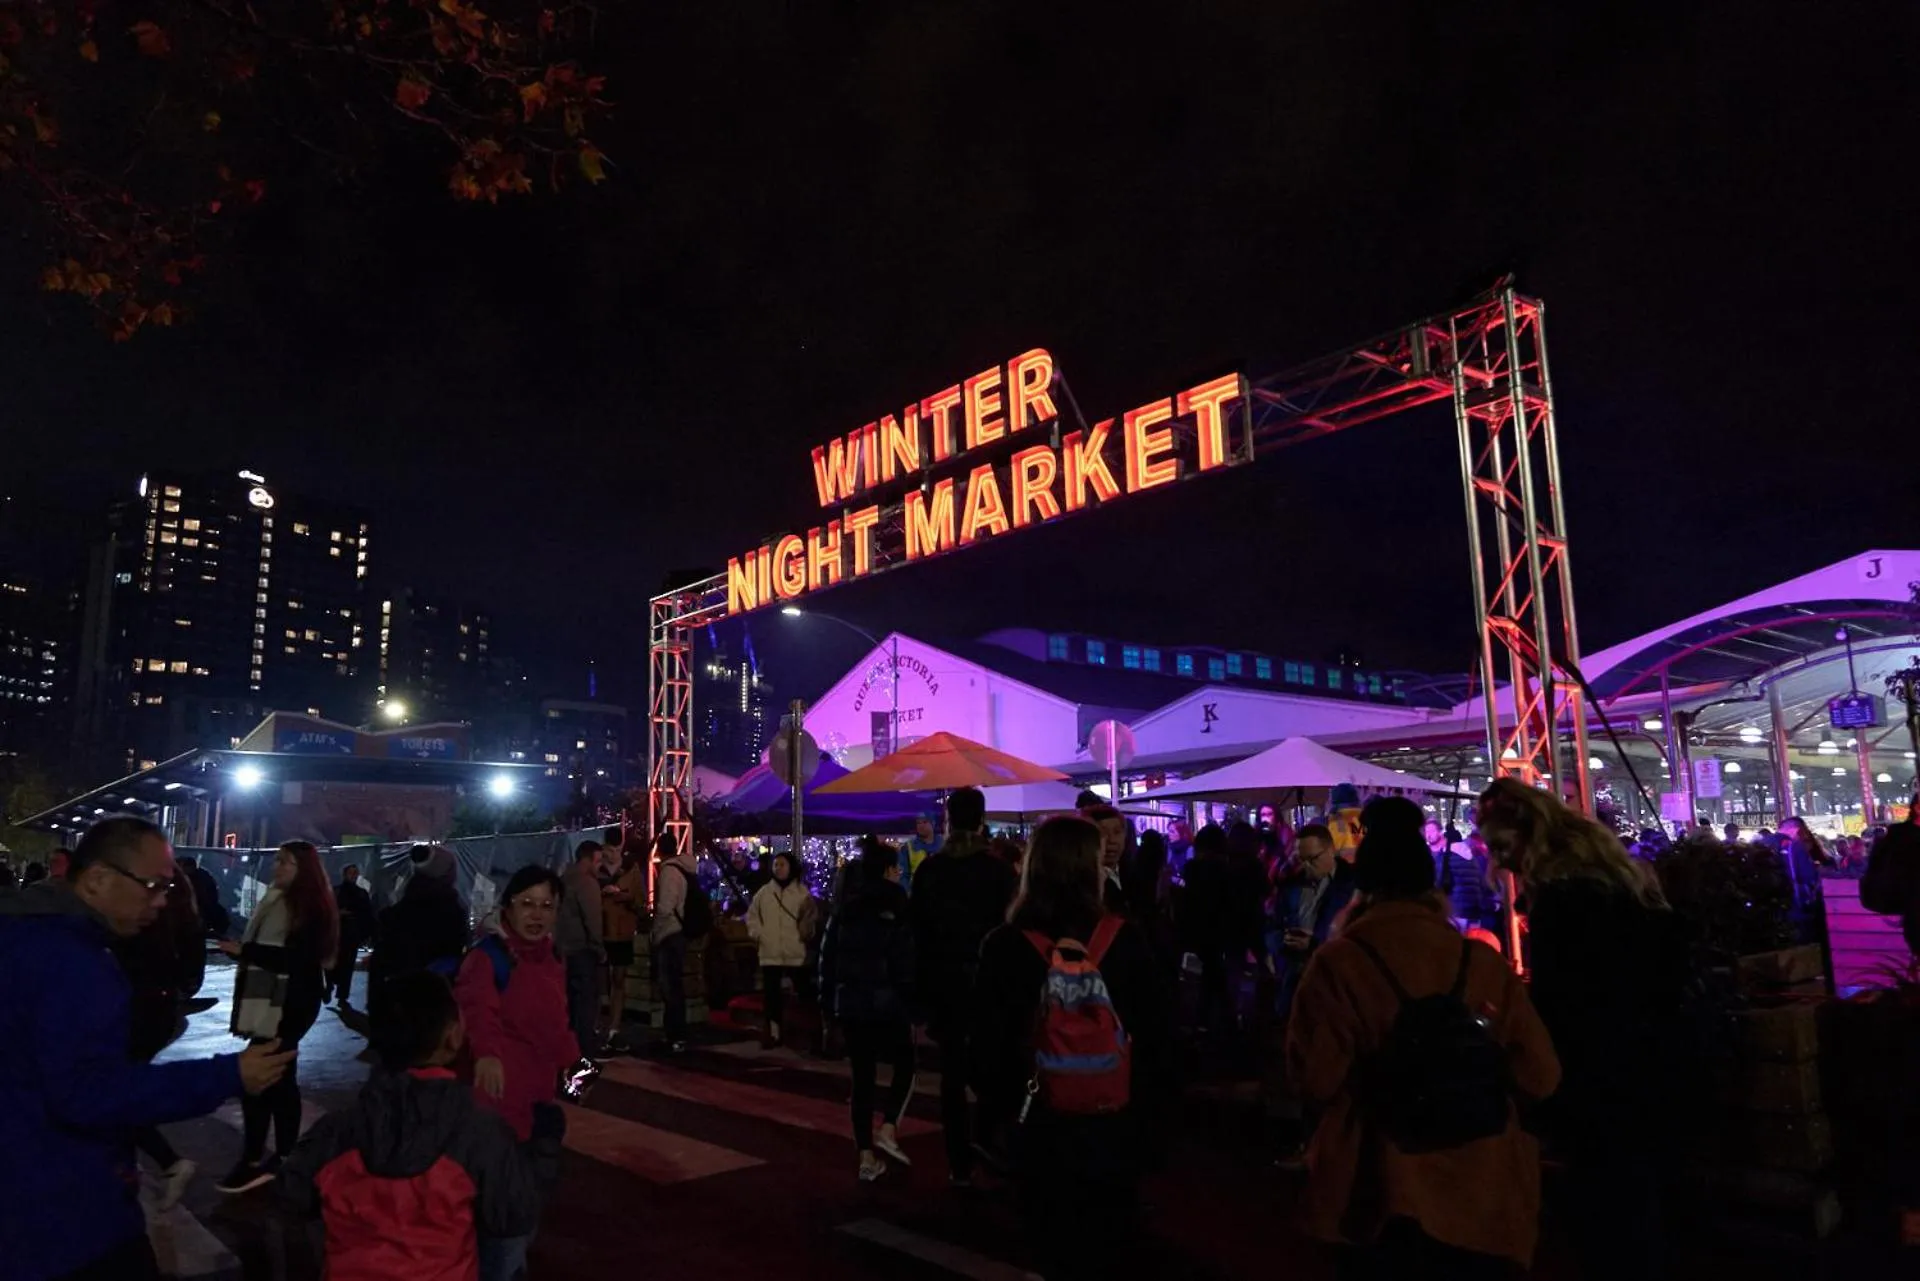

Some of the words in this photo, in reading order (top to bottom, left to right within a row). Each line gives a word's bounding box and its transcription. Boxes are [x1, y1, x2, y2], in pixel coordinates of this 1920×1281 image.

[811, 347, 1059, 508] WINTER
[727, 504, 879, 616] NIGHT
[904, 371, 1240, 561] MARKET
[1866, 558, 1882, 578] J
[854, 662, 884, 712] QUEN
